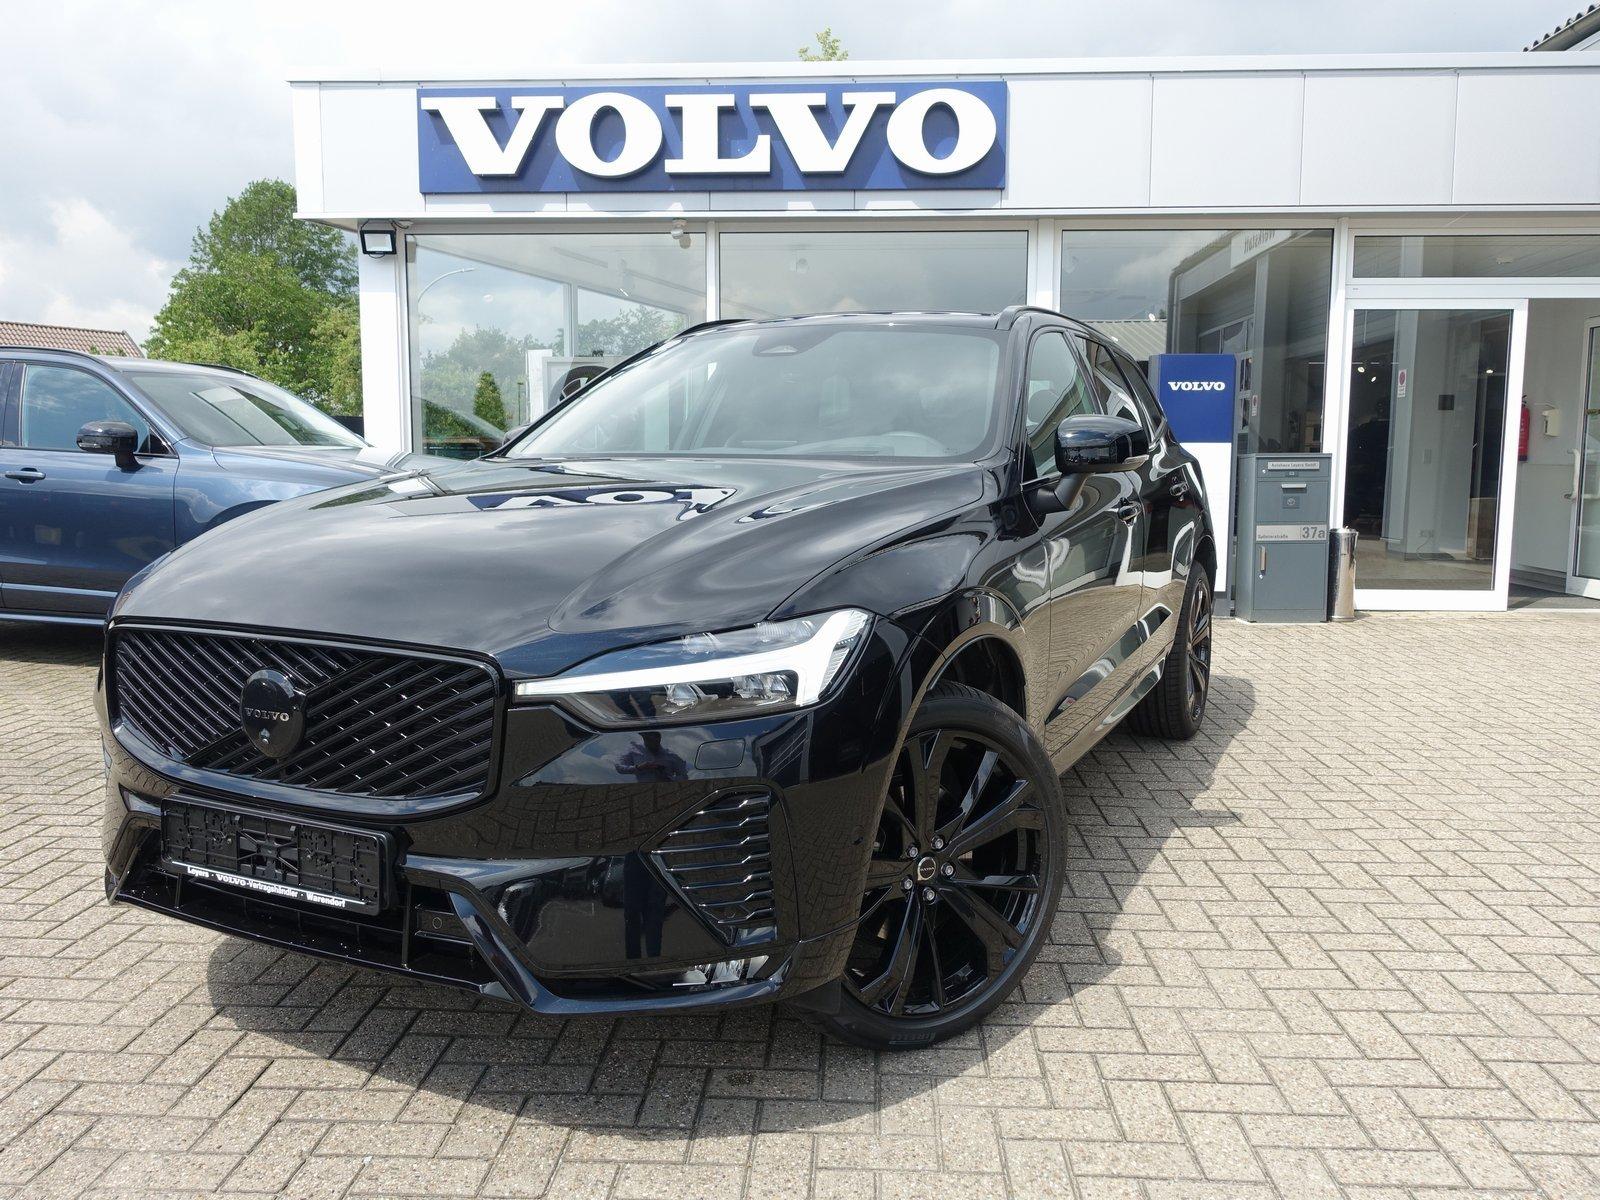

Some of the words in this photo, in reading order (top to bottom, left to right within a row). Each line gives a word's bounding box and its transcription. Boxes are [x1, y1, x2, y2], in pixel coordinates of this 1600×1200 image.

[420, 88, 997, 178] VOLVO
[1167, 381, 1226, 391] VOLVO
[1302, 526, 1326, 539] 37a
[244, 706, 290, 722] VOLVO
[187, 866, 210, 878] Leyers
[306, 892, 346, 908] Warendorf
